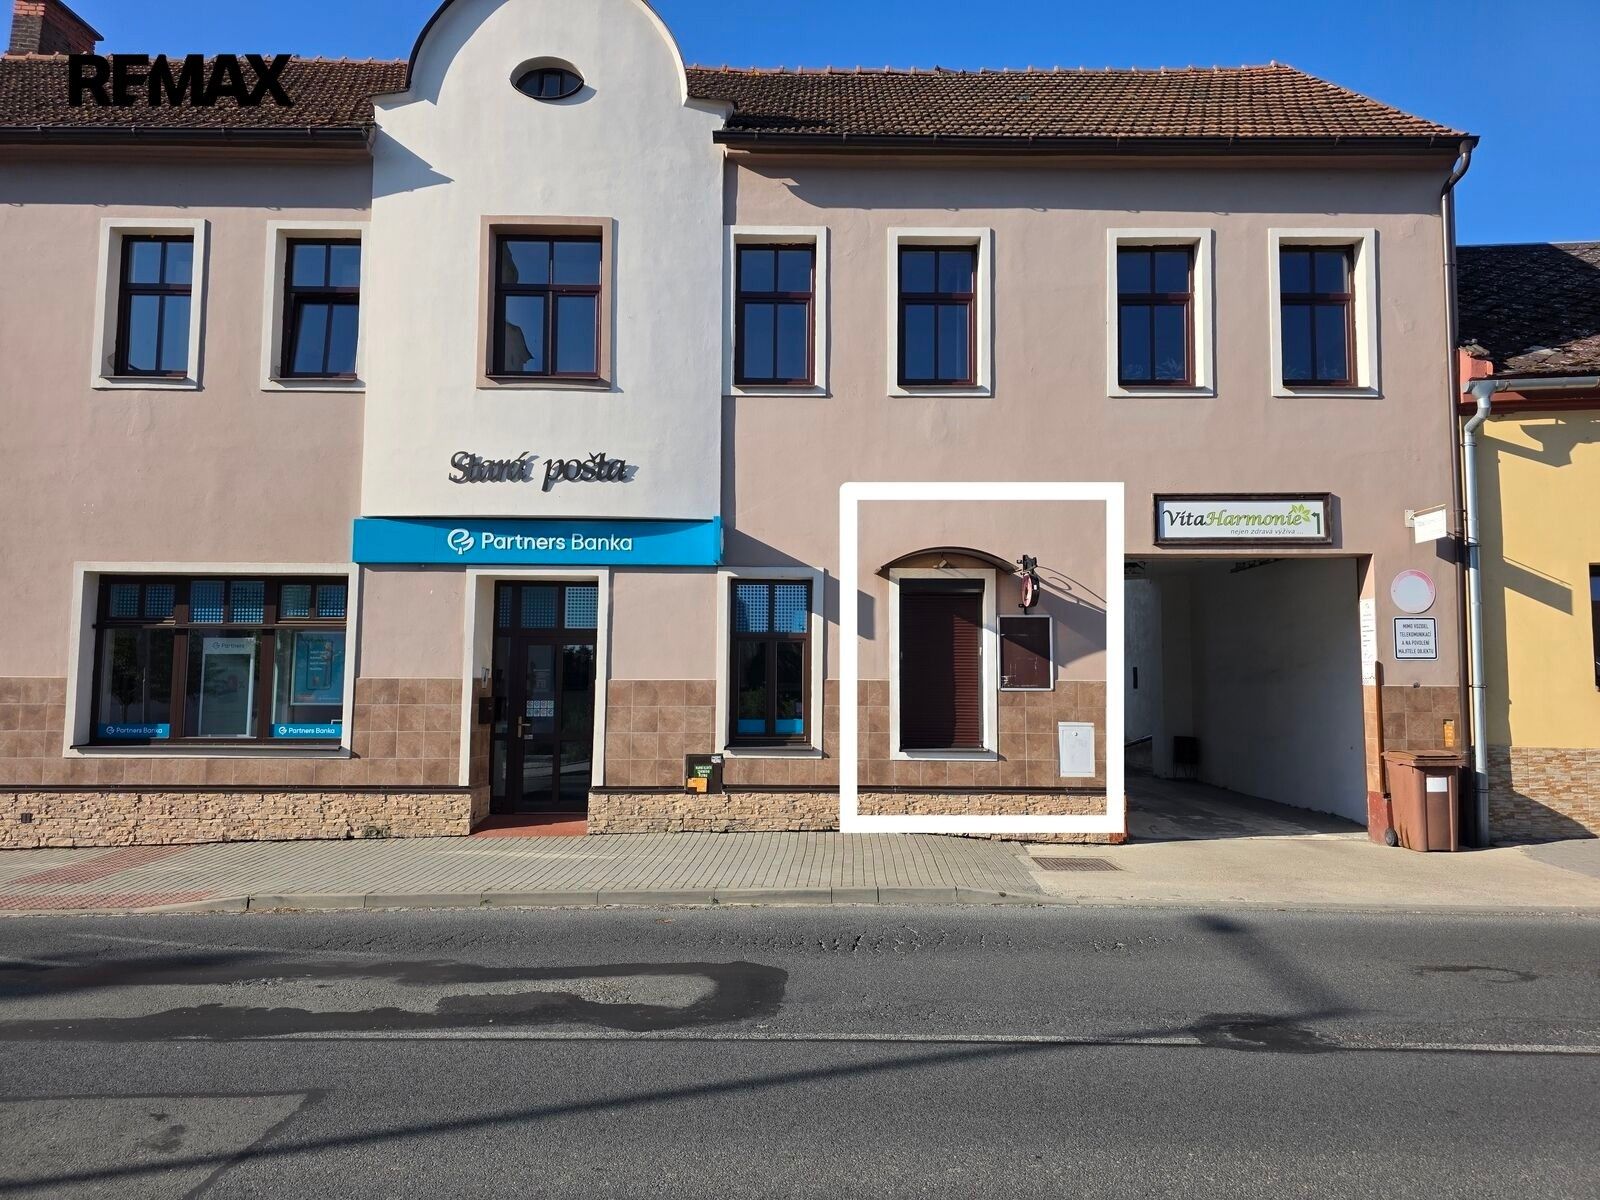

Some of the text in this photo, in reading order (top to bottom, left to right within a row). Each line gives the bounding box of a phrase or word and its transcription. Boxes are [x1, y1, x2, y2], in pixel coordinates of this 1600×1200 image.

[449, 451, 626, 491] Stará pošta
[482, 532, 633, 551] Partners Banka
